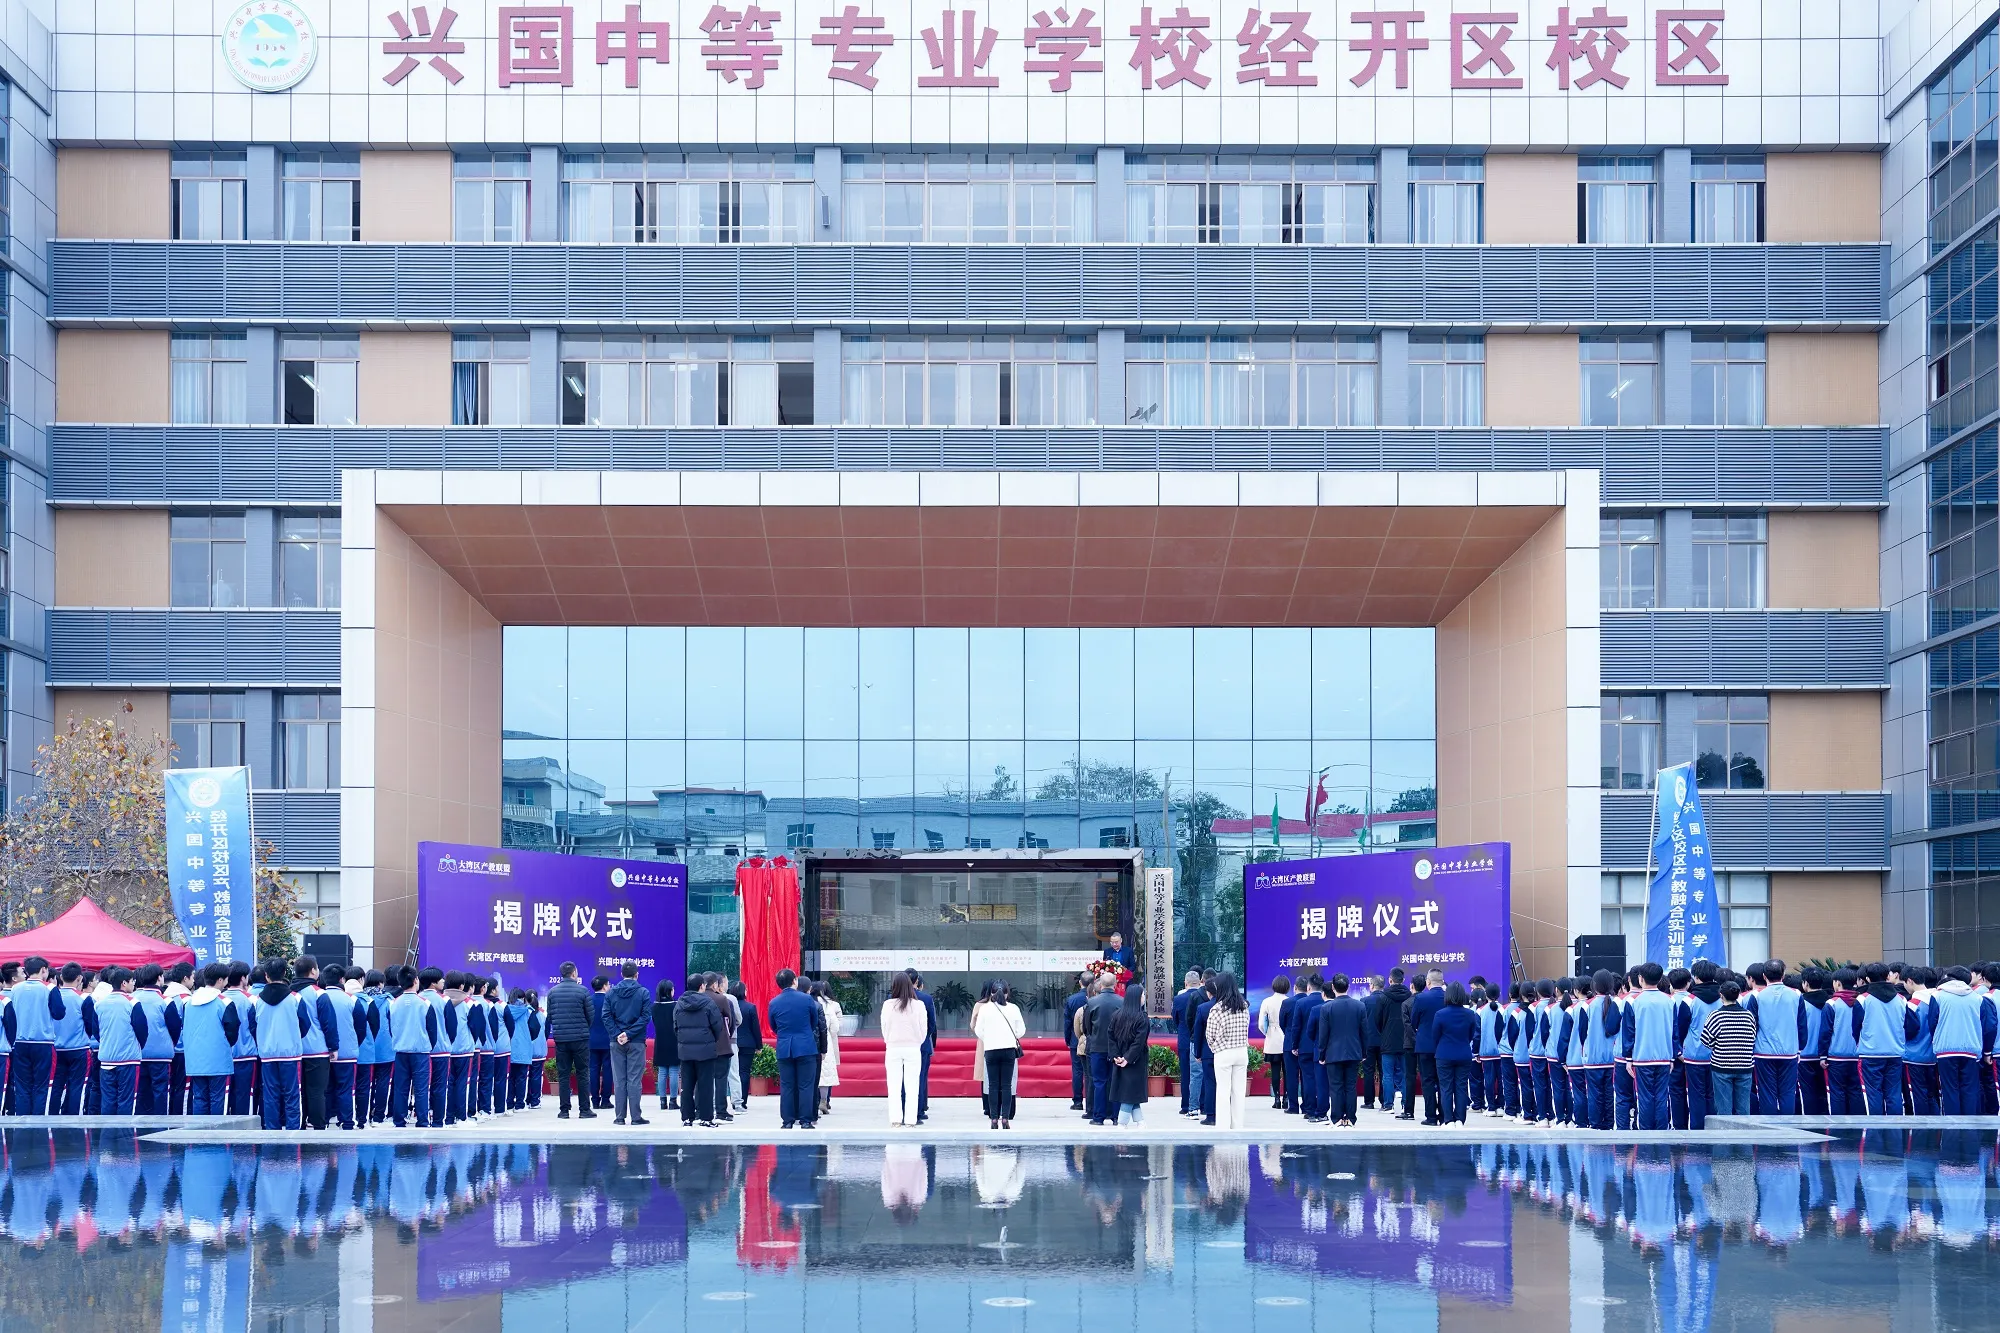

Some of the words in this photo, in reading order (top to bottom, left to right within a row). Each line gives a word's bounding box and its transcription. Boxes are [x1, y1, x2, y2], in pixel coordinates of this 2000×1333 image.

[382, 4, 1729, 91] 兴国中等专业学校经开区校区
[493, 899, 633, 941] 揭牌仪式
[1301, 900, 1439, 940] 揭牌仪式
[468, 951, 524, 964] 大湾区产教联盟
[1279, 957, 1328, 968] 大湾区产教联盟
[1401, 952, 1465, 964] 兴国中等专业学校
